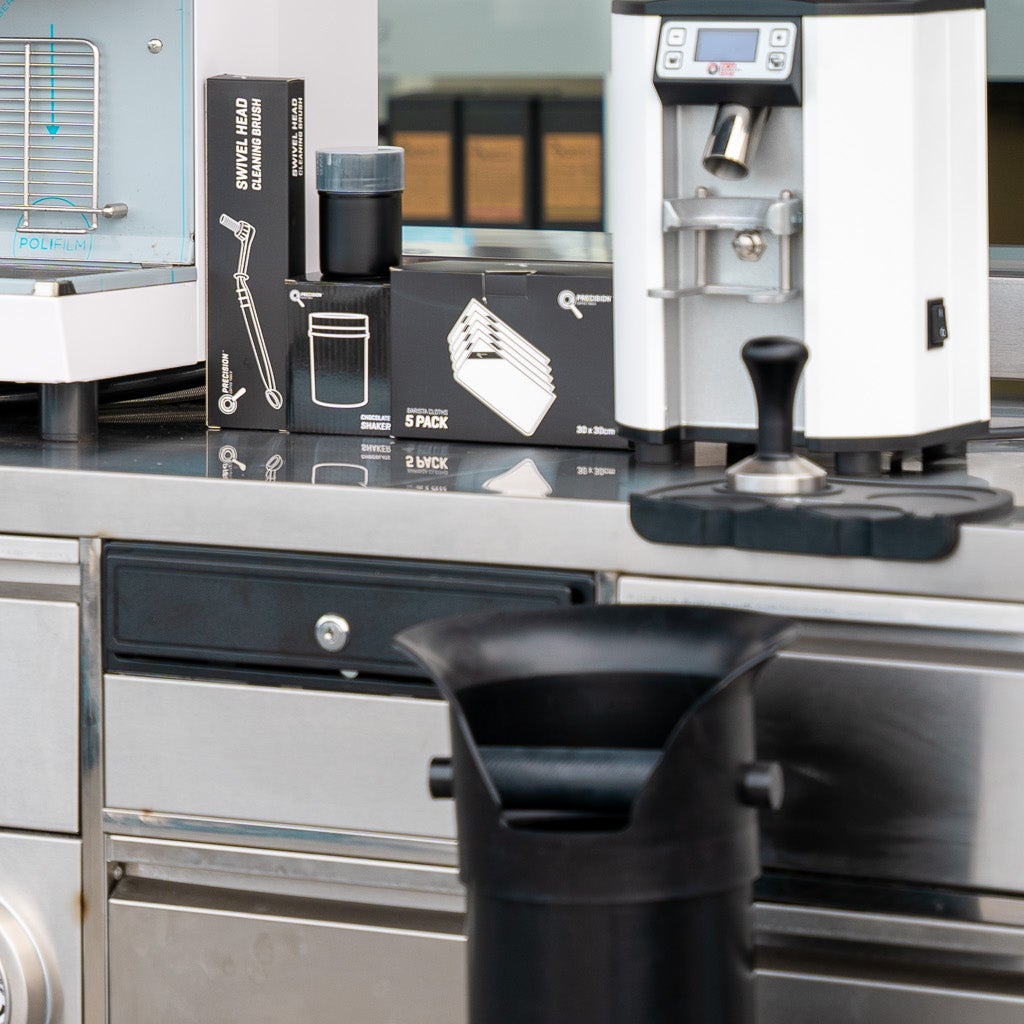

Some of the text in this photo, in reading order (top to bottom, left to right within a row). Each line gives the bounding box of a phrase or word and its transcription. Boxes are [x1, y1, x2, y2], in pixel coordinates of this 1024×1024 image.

[236, 97, 248, 191] SWIVEL HEAD
[251, 98, 262, 191] CLEANING BRUSH
[19, 236, 87, 252] POLIFILM
[576, 294, 613, 303] PRECISION
[221, 353, 229, 393] PRECISION
[360, 421, 391, 431] SHAKER
[405, 414, 448, 429] 5 PACK
